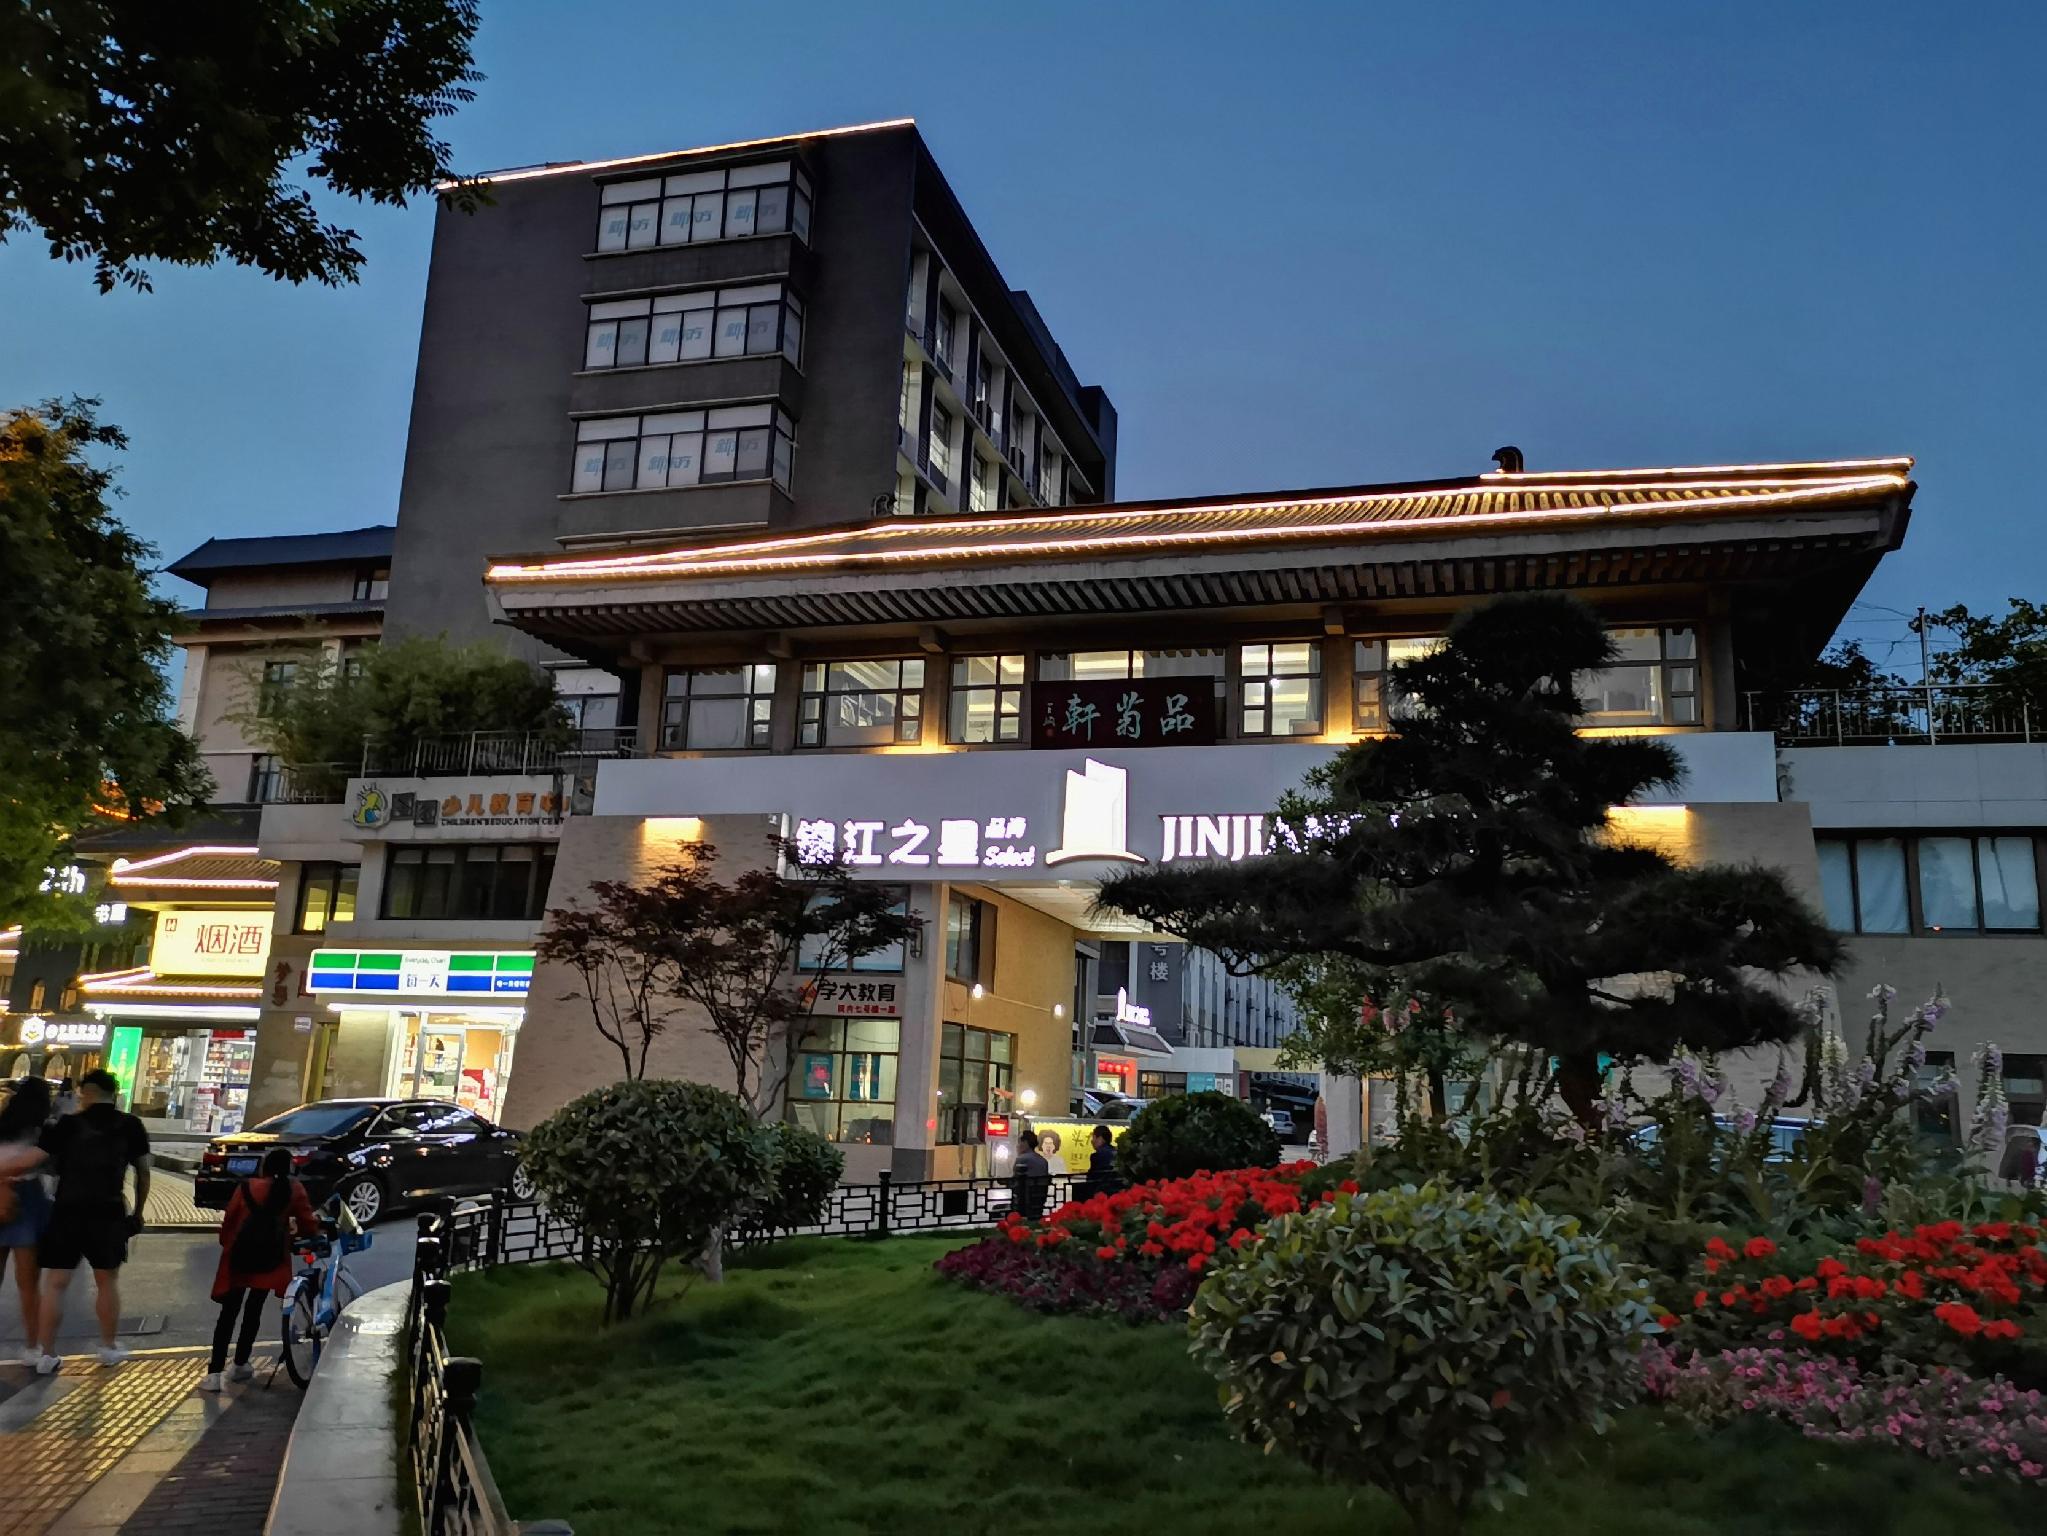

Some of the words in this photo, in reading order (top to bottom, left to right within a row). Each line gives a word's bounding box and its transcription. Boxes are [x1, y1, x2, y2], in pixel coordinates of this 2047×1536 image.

[796, 817, 980, 866] 锦江之星
[194, 923, 264, 955] 烟酒
[819, 982, 896, 1002] 学大教育
